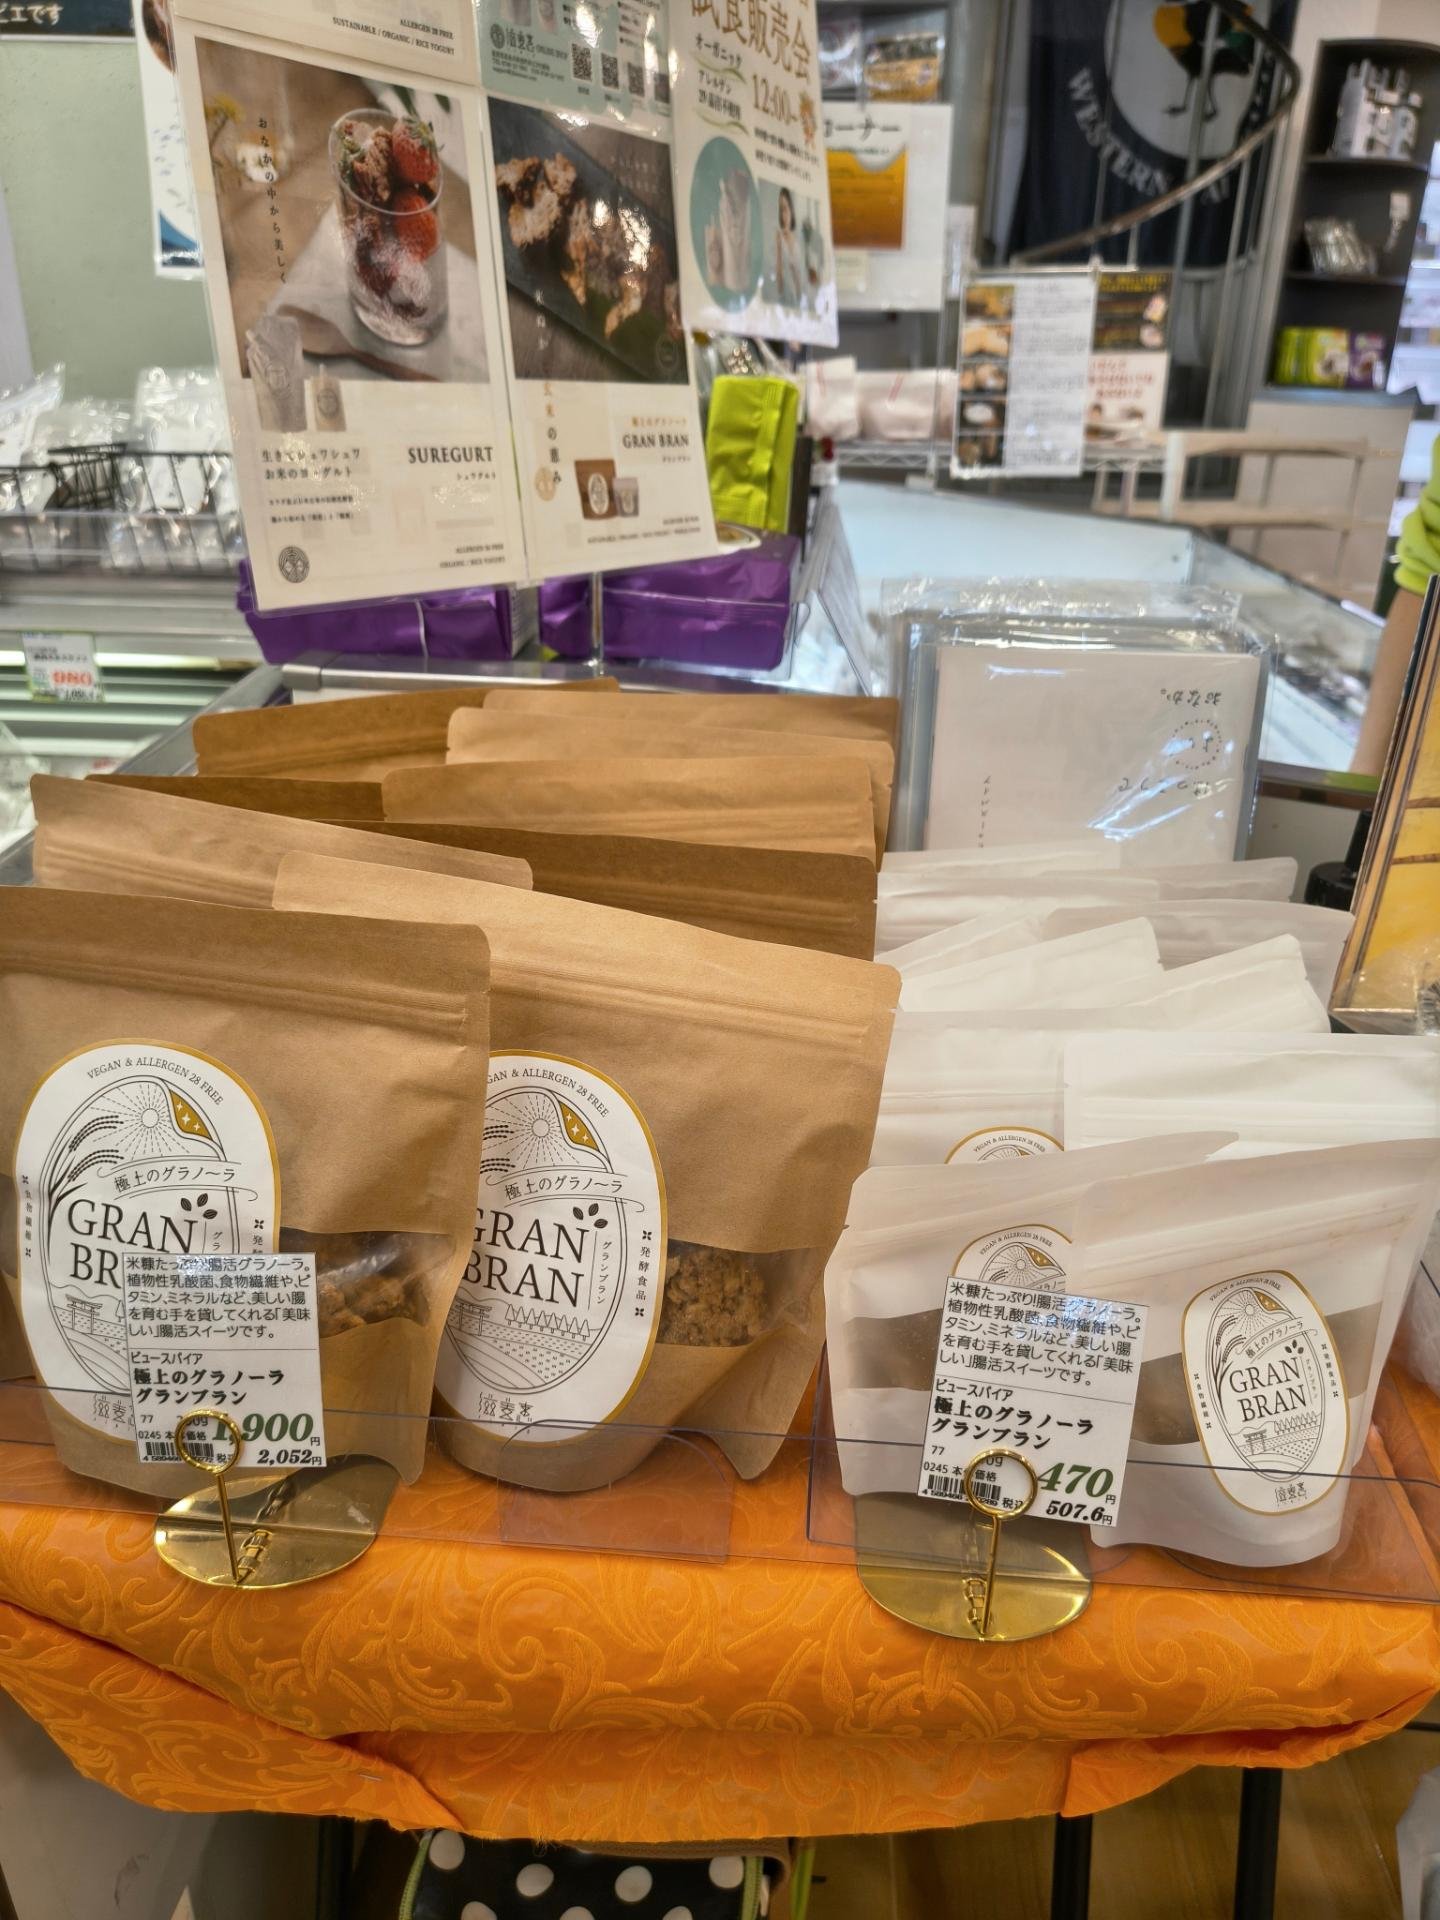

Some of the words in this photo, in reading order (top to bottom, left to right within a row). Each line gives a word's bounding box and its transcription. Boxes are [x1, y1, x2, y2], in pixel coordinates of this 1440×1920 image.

[332, 17, 376, 35] SUSTAINABLE
[696, 33, 743, 70] オーガニック
[258, 118, 287, 284] おなかの中から美しく
[408, 446, 493, 464] SUREGURT
[623, 434, 656, 449] GRAN
[658, 434, 689, 448] BRAN
[87, 1059, 121, 1079] VEGAN
[125, 1057, 133, 1067] &
[136, 1057, 190, 1078] ALLERGEN
[188, 1073, 202, 1085] 28
[200, 1081, 224, 1105] FREE
[487, 1070, 508, 1084] GAN
[511, 1069, 519, 1077] &
[522, 1068, 577, 1089] ALLERGEN
[576, 1085, 588, 1096] 28
[587, 1094, 610, 1118] FREE
[974, 1140, 991, 1152] VEGAN
[67, 1199, 198, 1254] GRAN
[980, 1240, 997, 1255] VEGAN
[1003, 1232, 1032, 1241] ALLERGEN
[70, 1242, 122, 1289] BR
[463, 1251, 584, 1308] BRAN
[597, 1241, 613, 1305] グランブラン
[635, 1246, 651, 1301] 発酵食品
[128, 1290, 306, 1306] タミン、ミネラルなど、美しい腸
[128, 1307, 311, 1322] を育む手を貸してくれる「美味
[128, 1324, 275, 1339] しい」腸活スイーツです。
[945, 1316, 1132, 1357] タミン、ミネラルなど、美しい腸
[942, 1333, 1134, 1374] を育む手を貸してくれる「美味
[133, 1368, 285, 1386] 極上のグラノーラ
[939, 1350, 1092, 1386] しい」腸活スイーツです。
[1229, 1357, 1302, 1394] GRAN
[136, 1388, 248, 1406] グランブラン
[1238, 1385, 1307, 1422] BRAN
[141, 1415, 154, 1424] 77
[934, 1396, 1094, 1435] 極上のグラノーラ
[138, 1431, 162, 1440] 0245
[165, 1431, 207, 1441] 本価格
[932, 1418, 1051, 1450] グランブラン
[257, 1449, 322, 1466] 2,052円
[931, 1445, 945, 1456] 77
[982, 1455, 1003, 1467] 0g
[923, 1461, 948, 1474] 0245
[952, 1466, 997, 1482] 本価格
[1046, 1501, 1112, 1525] 507.6円
